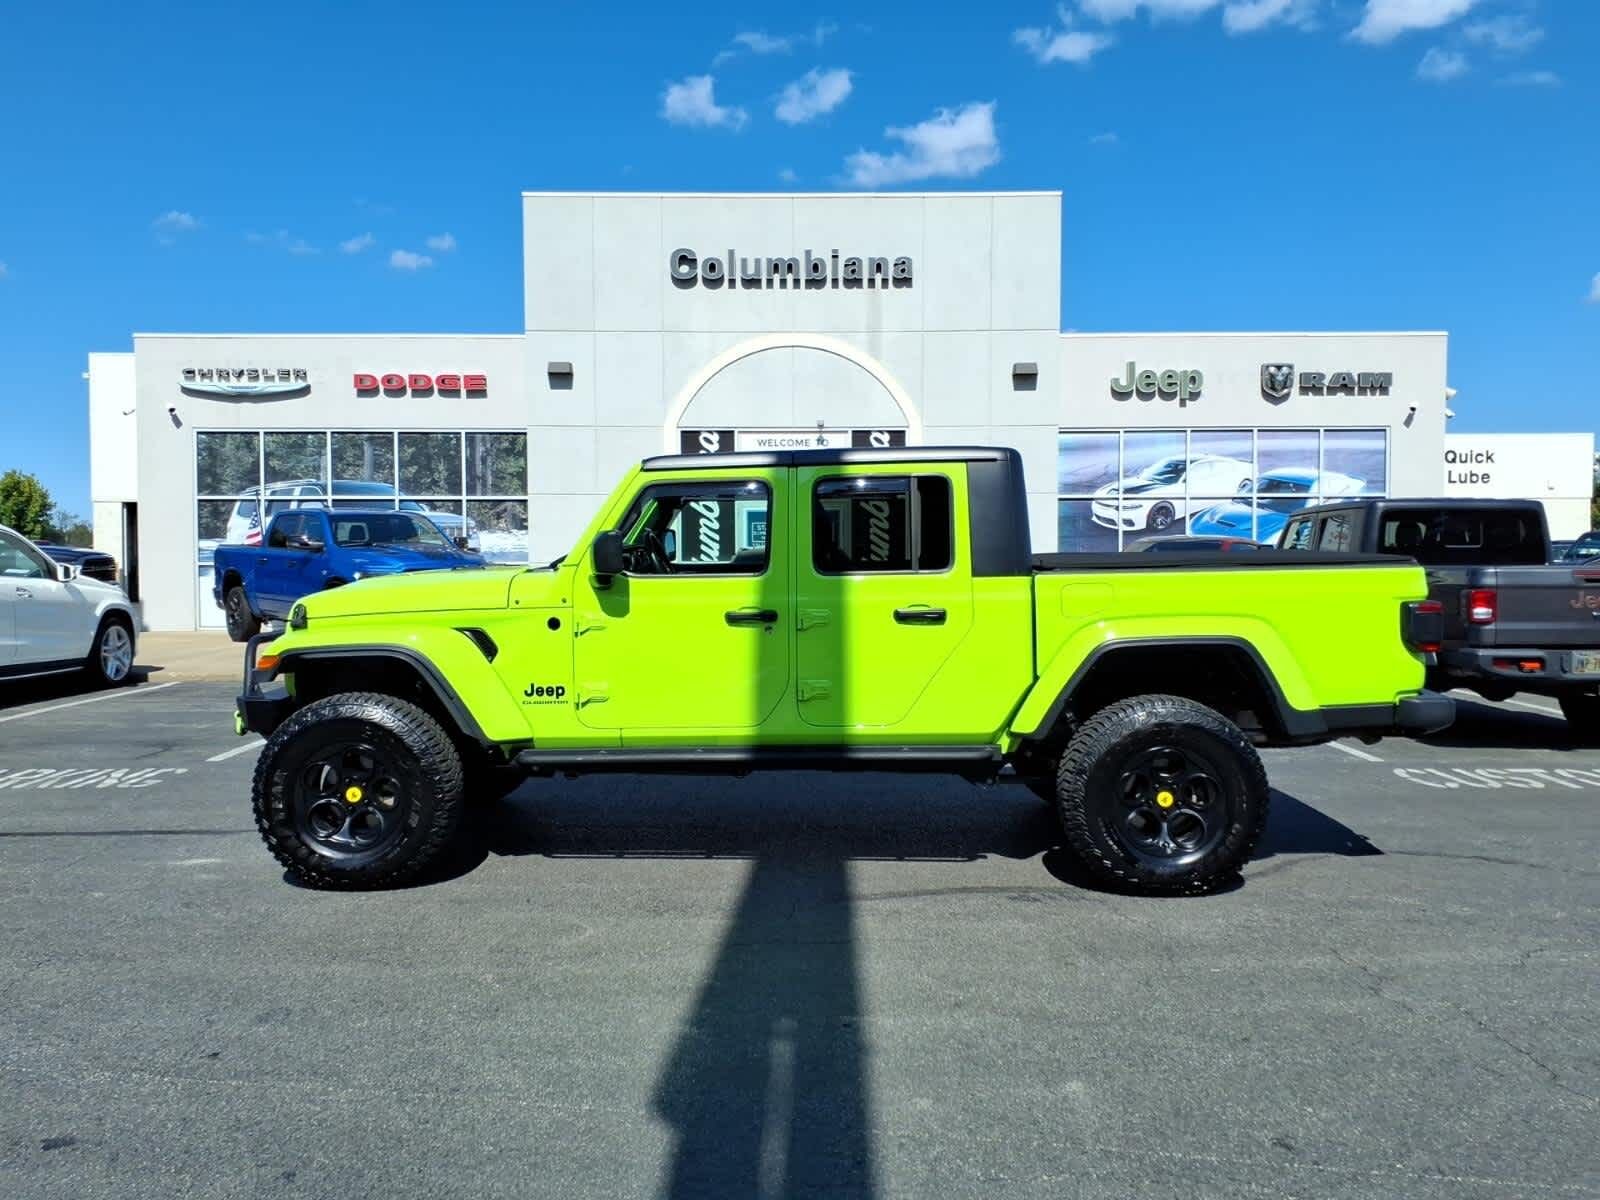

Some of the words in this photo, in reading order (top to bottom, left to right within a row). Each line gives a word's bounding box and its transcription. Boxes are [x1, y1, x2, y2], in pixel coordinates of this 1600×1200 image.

[670, 248, 913, 284] Columbiana
[182, 368, 308, 381] CHRYSLER
[353, 373, 487, 391] DODGE
[1111, 361, 1204, 402] Jeep
[1299, 372, 1393, 391] RAM
[756, 438, 810, 447] WELCOME
[1444, 449, 1495, 464] Quick
[1447, 470, 1490, 484] Lube
[1568, 590, 1600, 609] Je
[524, 682, 566, 699] Jeep
[0, 768, 189, 789] RKING
[1393, 767, 1600, 789] CUSTO
